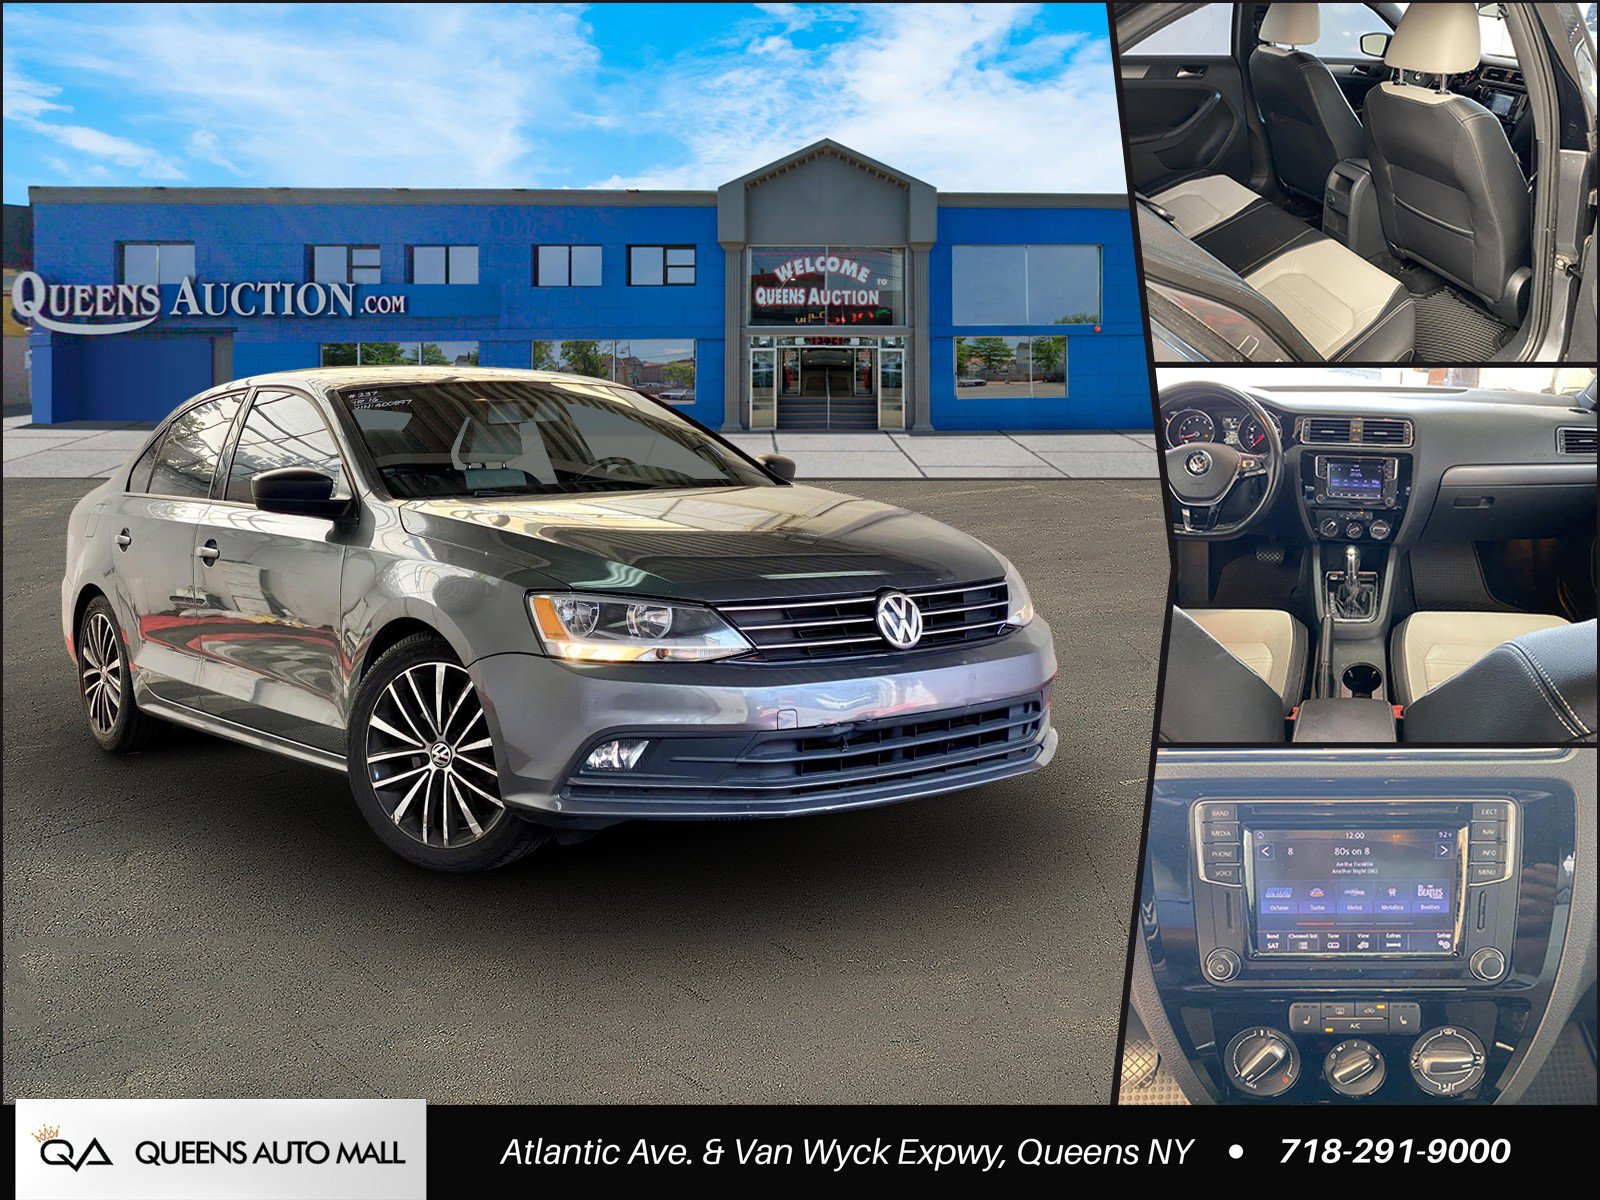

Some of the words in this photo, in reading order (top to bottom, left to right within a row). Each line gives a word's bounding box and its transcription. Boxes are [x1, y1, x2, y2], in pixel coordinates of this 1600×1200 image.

[773, 255, 872, 284] WELCOME
[877, 278, 888, 286] TO
[12, 271, 162, 335] QUEENS
[755, 287, 806, 306] QUEENS
[807, 288, 879, 306] AUCTION
[1334, 847, 1350, 855] 80s
